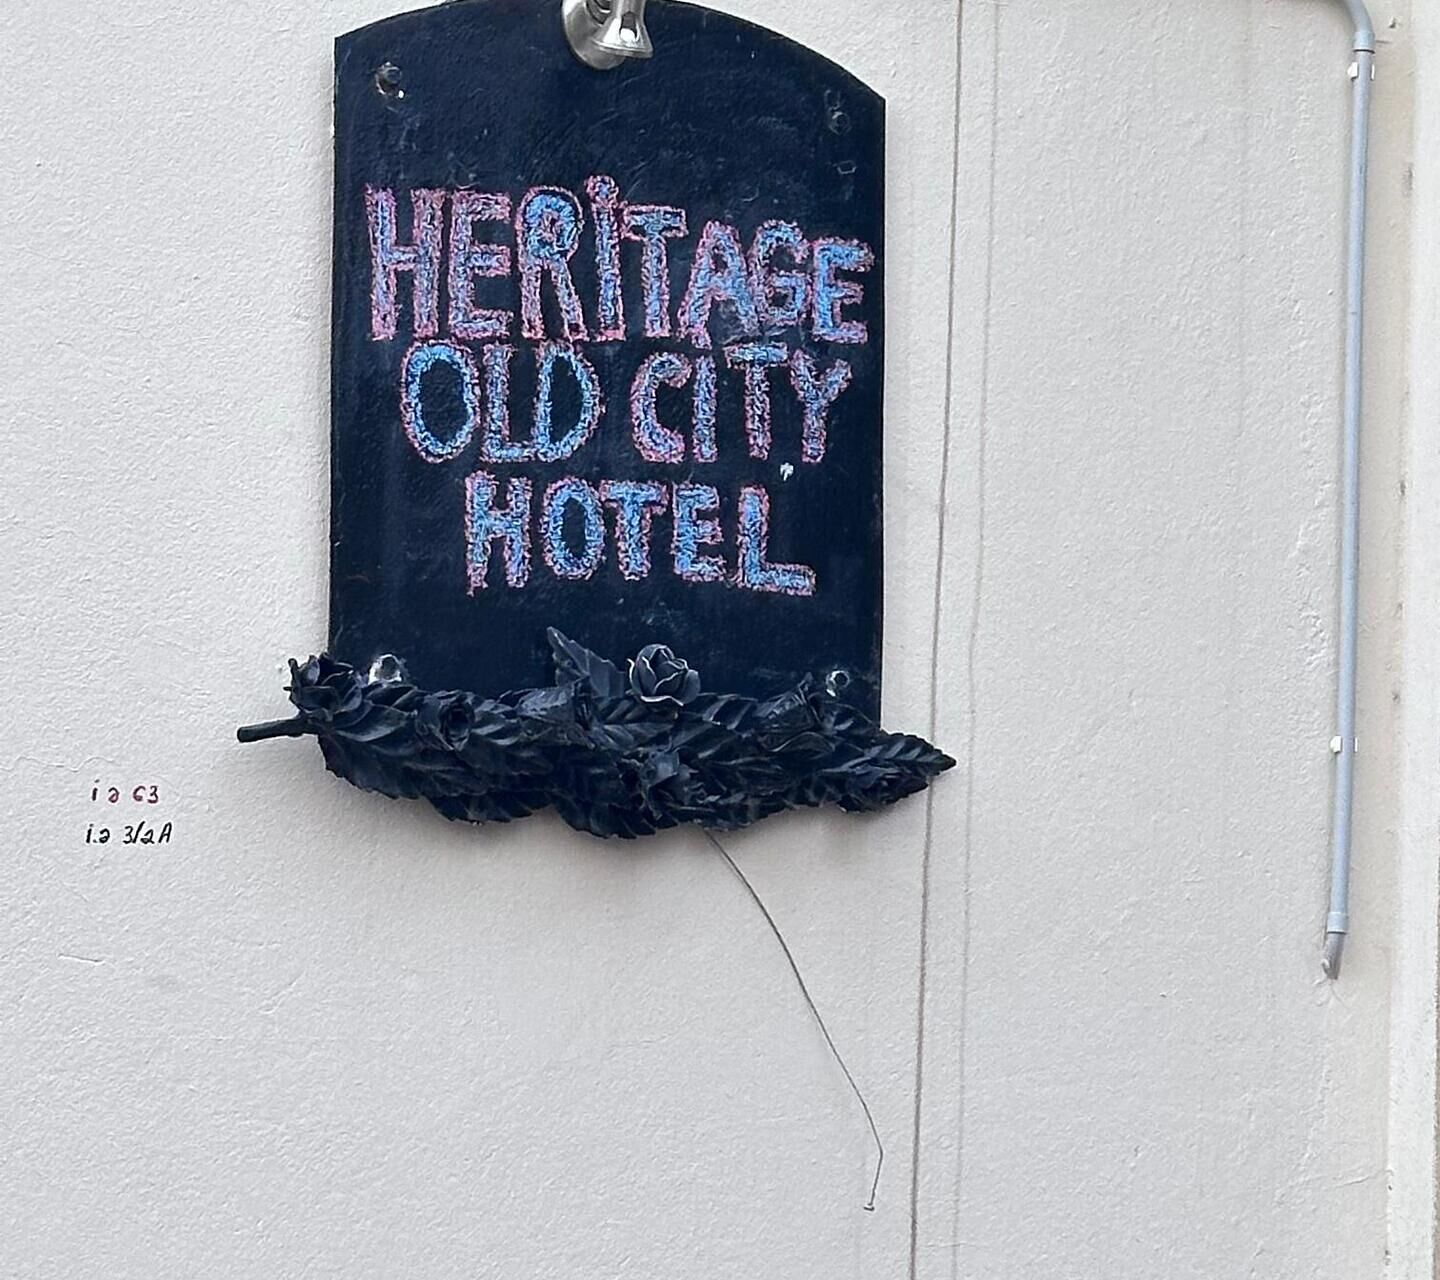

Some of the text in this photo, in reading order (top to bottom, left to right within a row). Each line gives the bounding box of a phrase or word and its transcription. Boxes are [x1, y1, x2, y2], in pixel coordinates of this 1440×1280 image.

[400, 339, 852, 464] OLD CITY
[464, 470, 816, 596] HOTEL
